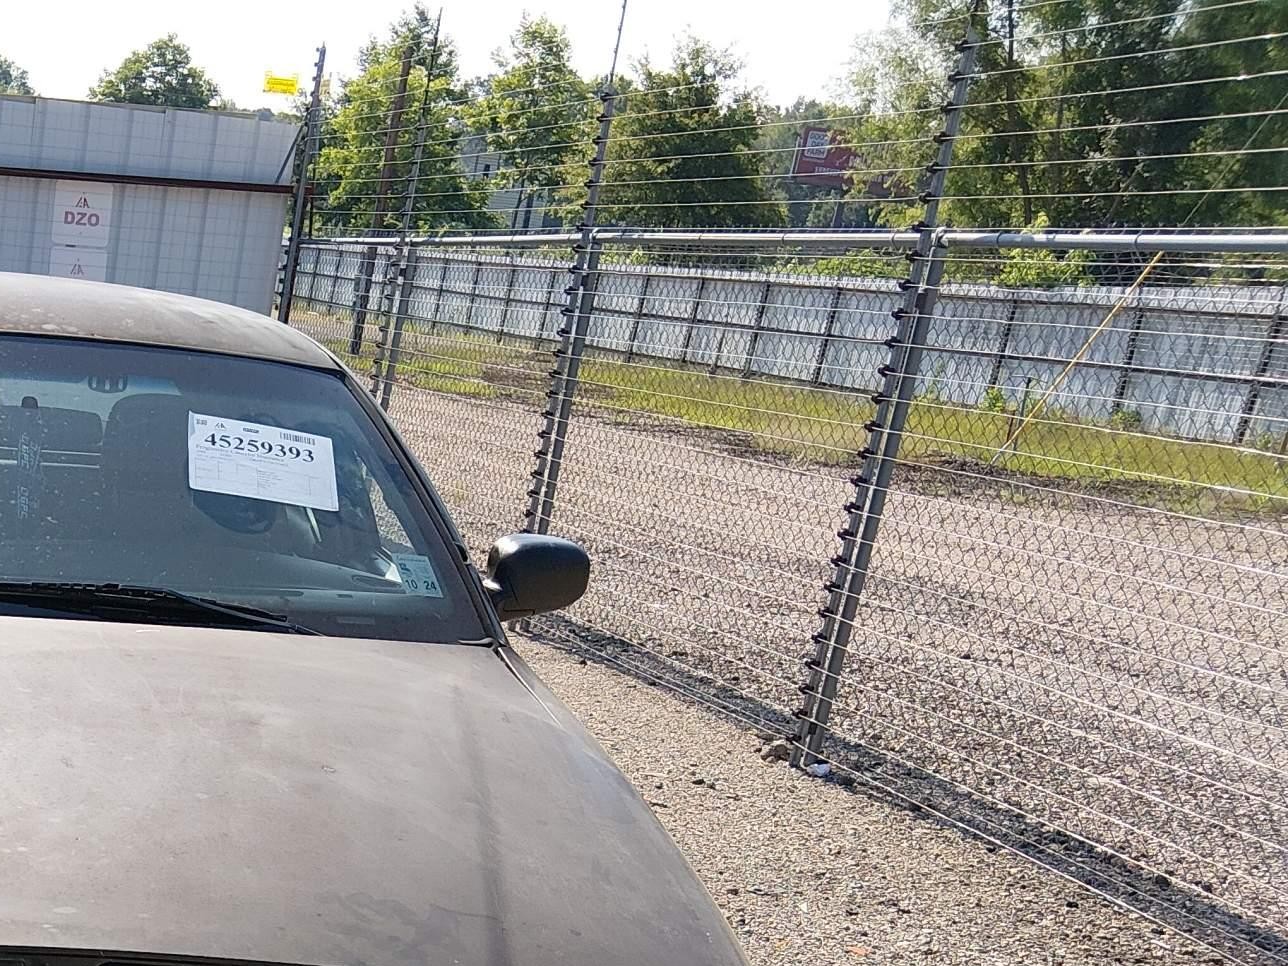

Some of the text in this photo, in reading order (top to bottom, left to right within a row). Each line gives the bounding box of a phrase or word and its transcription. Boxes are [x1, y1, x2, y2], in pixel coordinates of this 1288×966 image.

[63, 210, 100, 228] DZO
[204, 432, 315, 463] 45259393
[405, 578, 437, 592] 10 24
